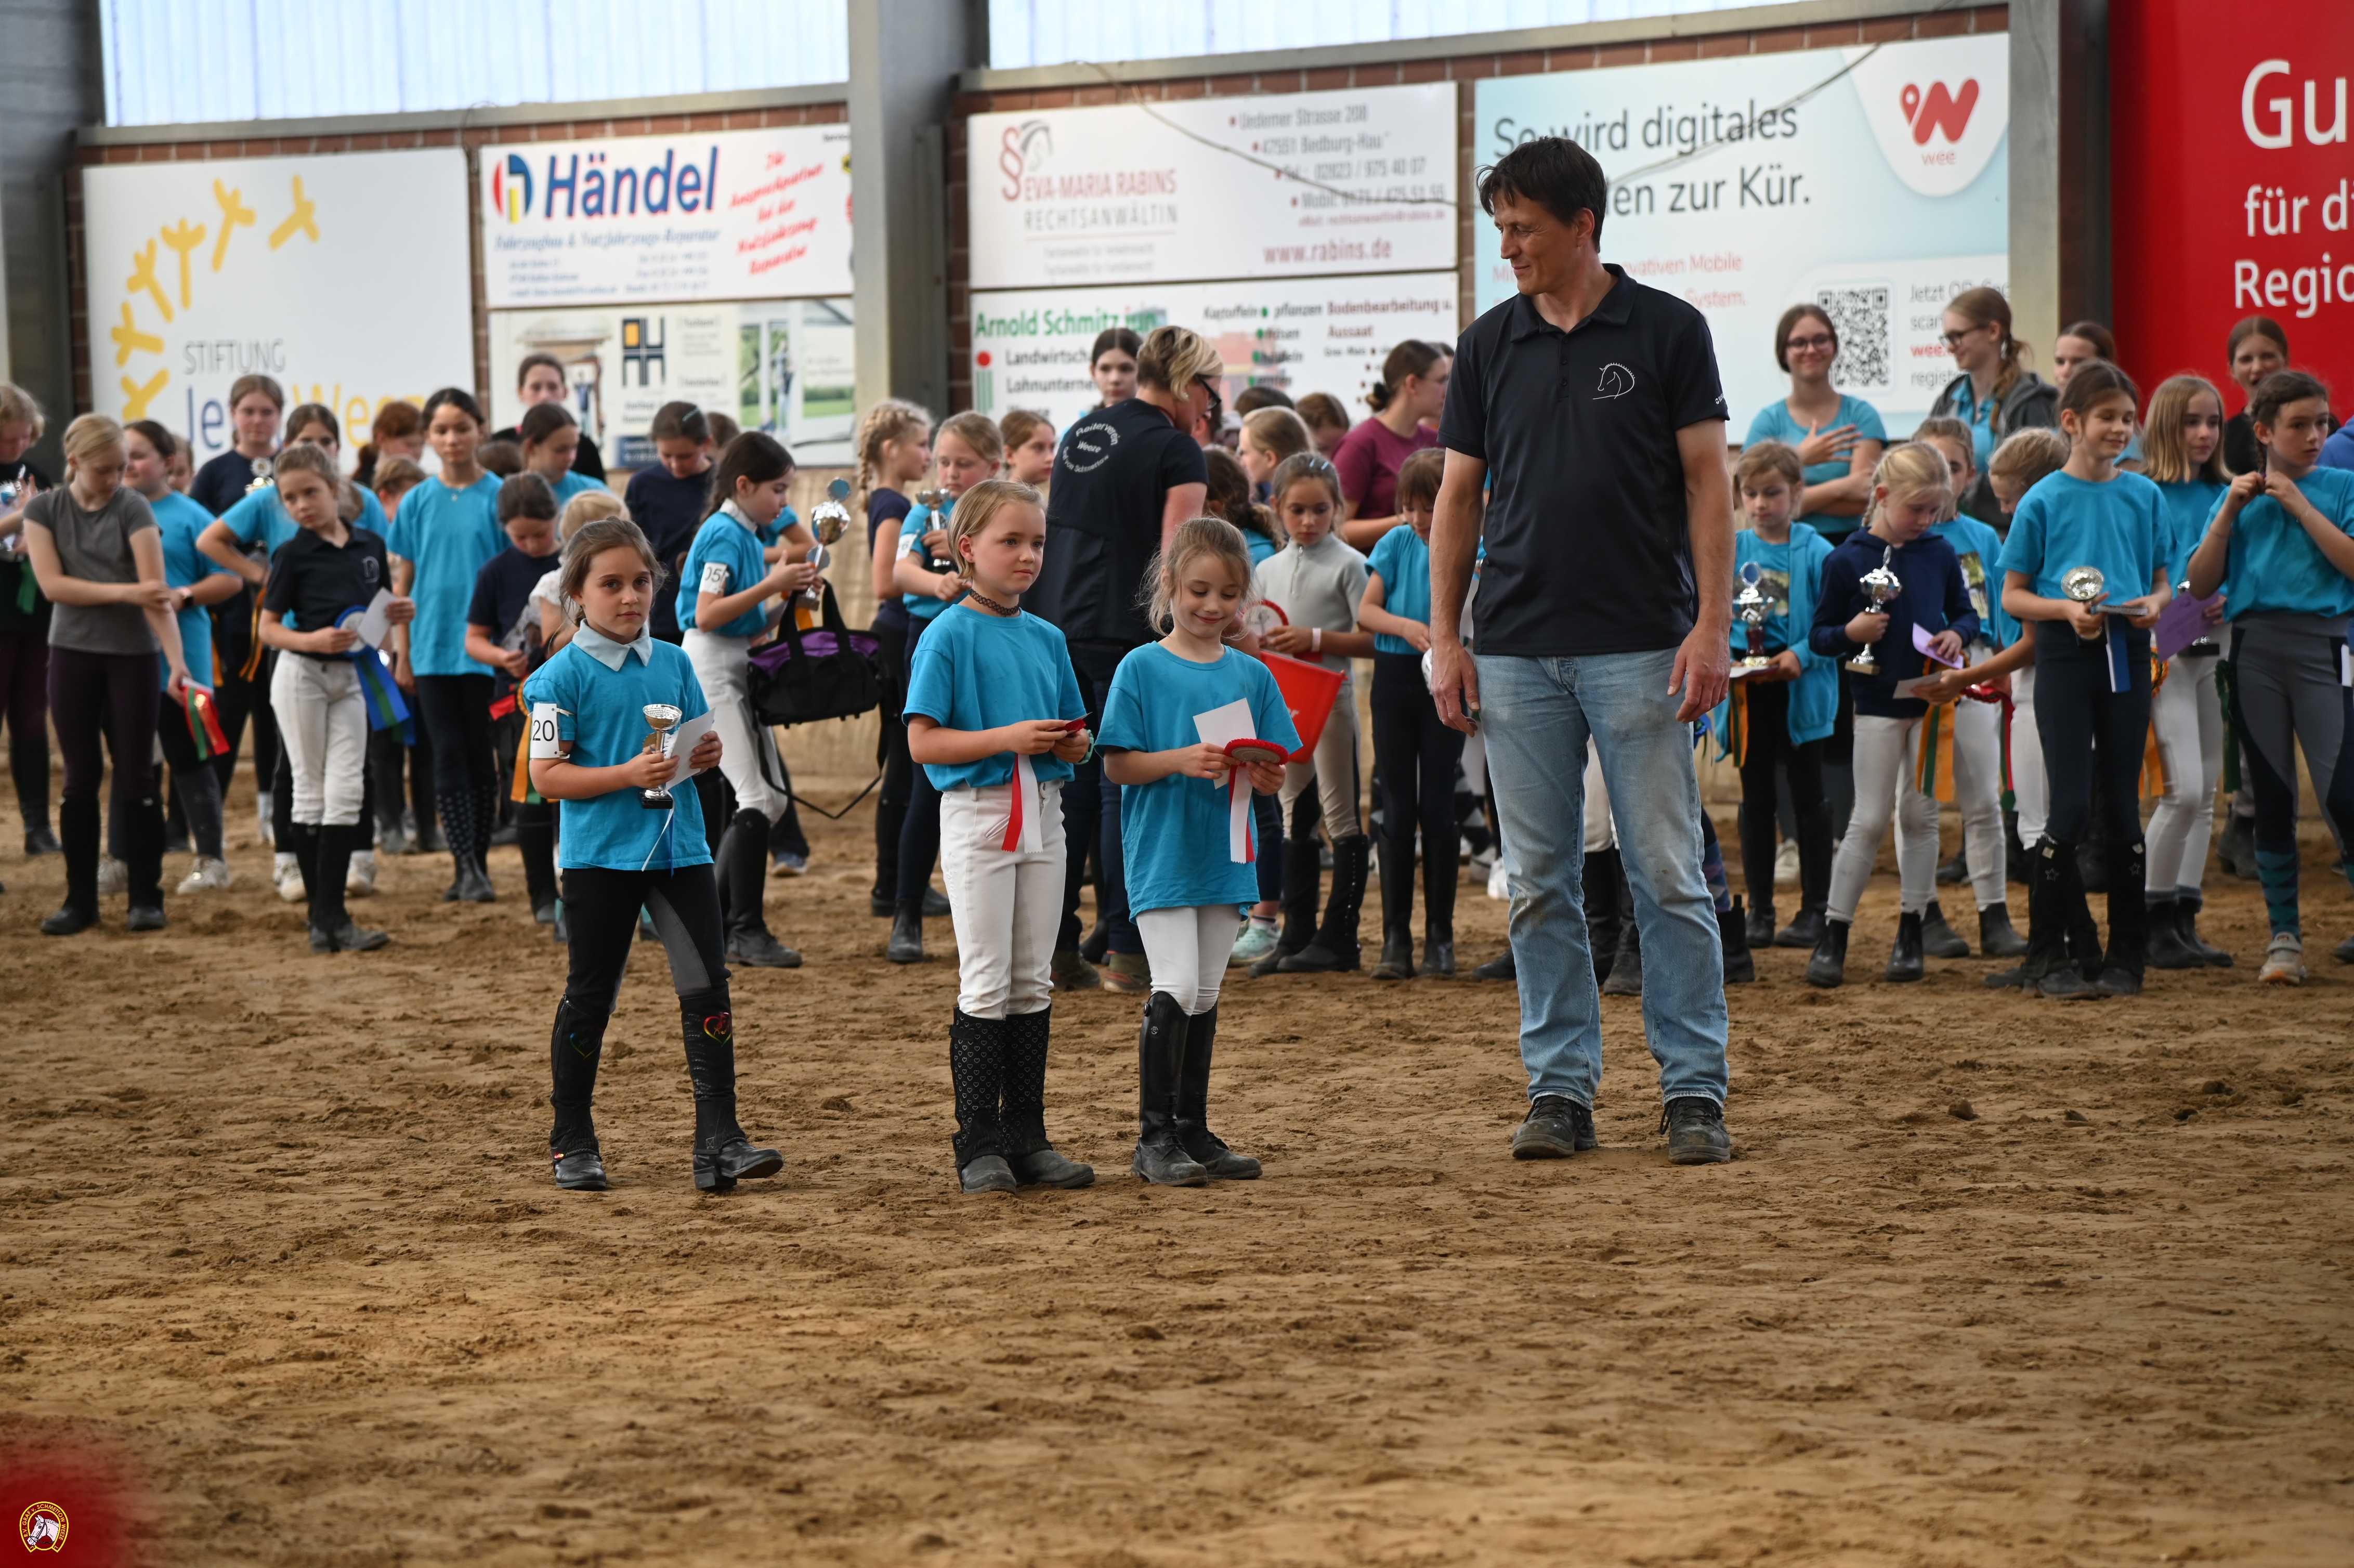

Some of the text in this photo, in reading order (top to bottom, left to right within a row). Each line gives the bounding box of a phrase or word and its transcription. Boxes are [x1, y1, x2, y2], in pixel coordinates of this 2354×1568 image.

[2242, 59, 2347, 150] Gu
[1296, 108, 1340, 127] Strasse
[1642, 99, 1799, 155] digitales
[1922, 152, 1955, 166] wee
[545, 146, 721, 219] Händel
[1116, 168, 1177, 195] RABINS
[1669, 178, 1726, 213] zur
[1739, 163, 1811, 208] Kür.
[2244, 184, 2309, 237] für
[1263, 238, 1392, 264] www.rabins.de
[1690, 252, 1743, 272] Mobile
[1910, 284, 1945, 302] Jetzt
[2234, 252, 2354, 318] Regio
[1327, 298, 1439, 315] Bodenbearbeitung
[975, 311, 1038, 336] Arnold
[184, 339, 285, 375] STIFTUNG
[1005, 347, 1092, 366] Landwirtsch
[1076, 423, 1120, 446] Reiterverein
[1077, 440, 1101, 453] Weeze
[533, 720, 555, 741] 20
